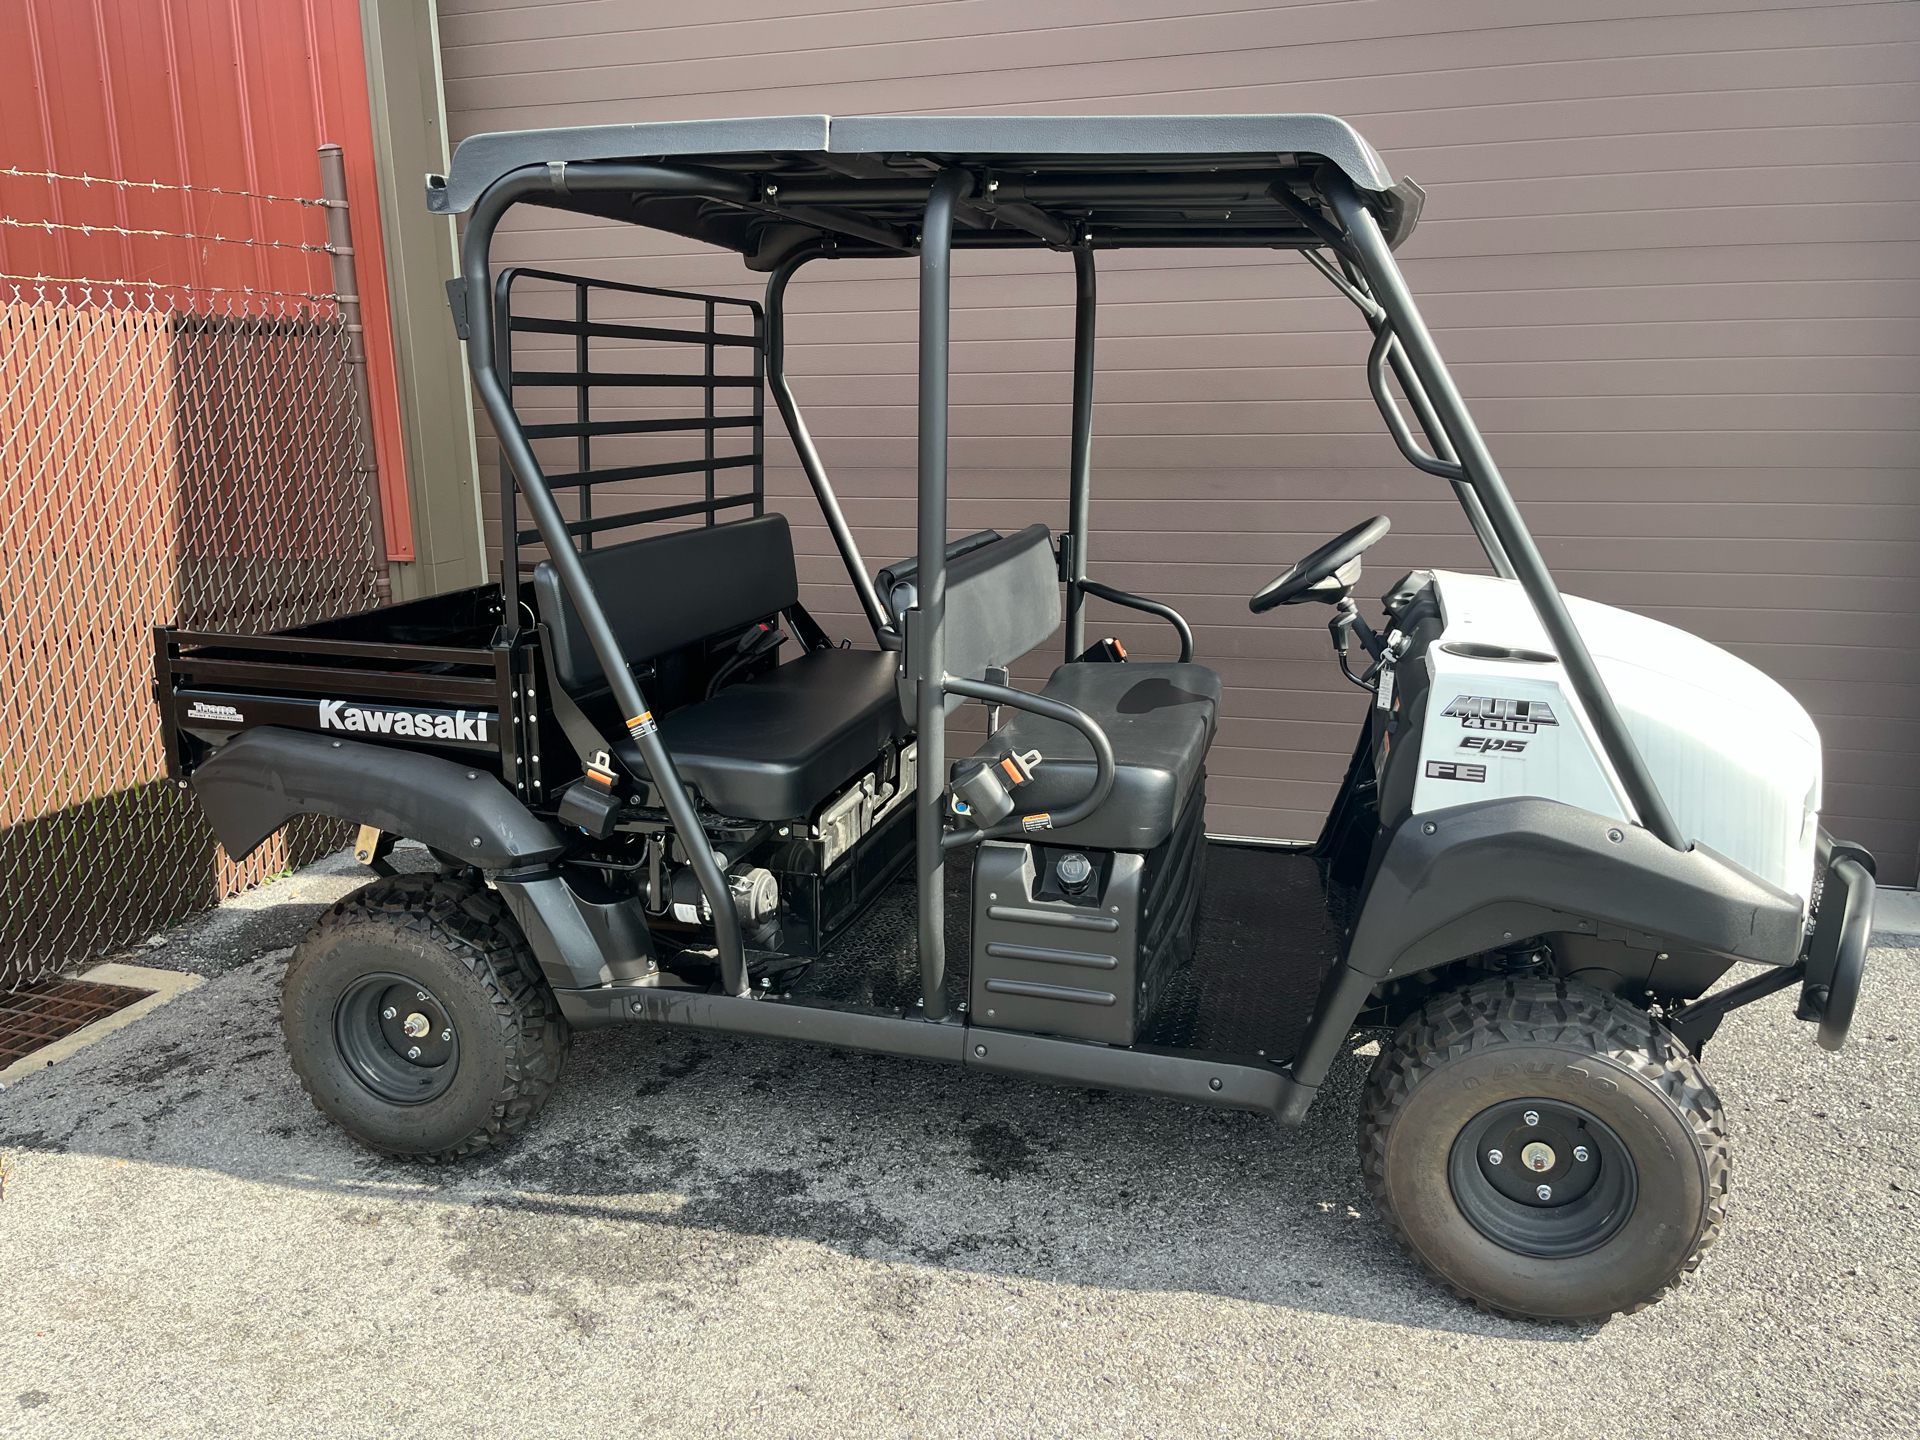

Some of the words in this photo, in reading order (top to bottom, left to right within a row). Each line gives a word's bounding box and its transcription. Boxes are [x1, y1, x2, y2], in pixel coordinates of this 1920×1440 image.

[319, 699, 488, 742] Kawasaki
[1441, 696, 1559, 726] MULE
[1463, 718, 1536, 734] 4010
[1427, 762, 1484, 781] FE
